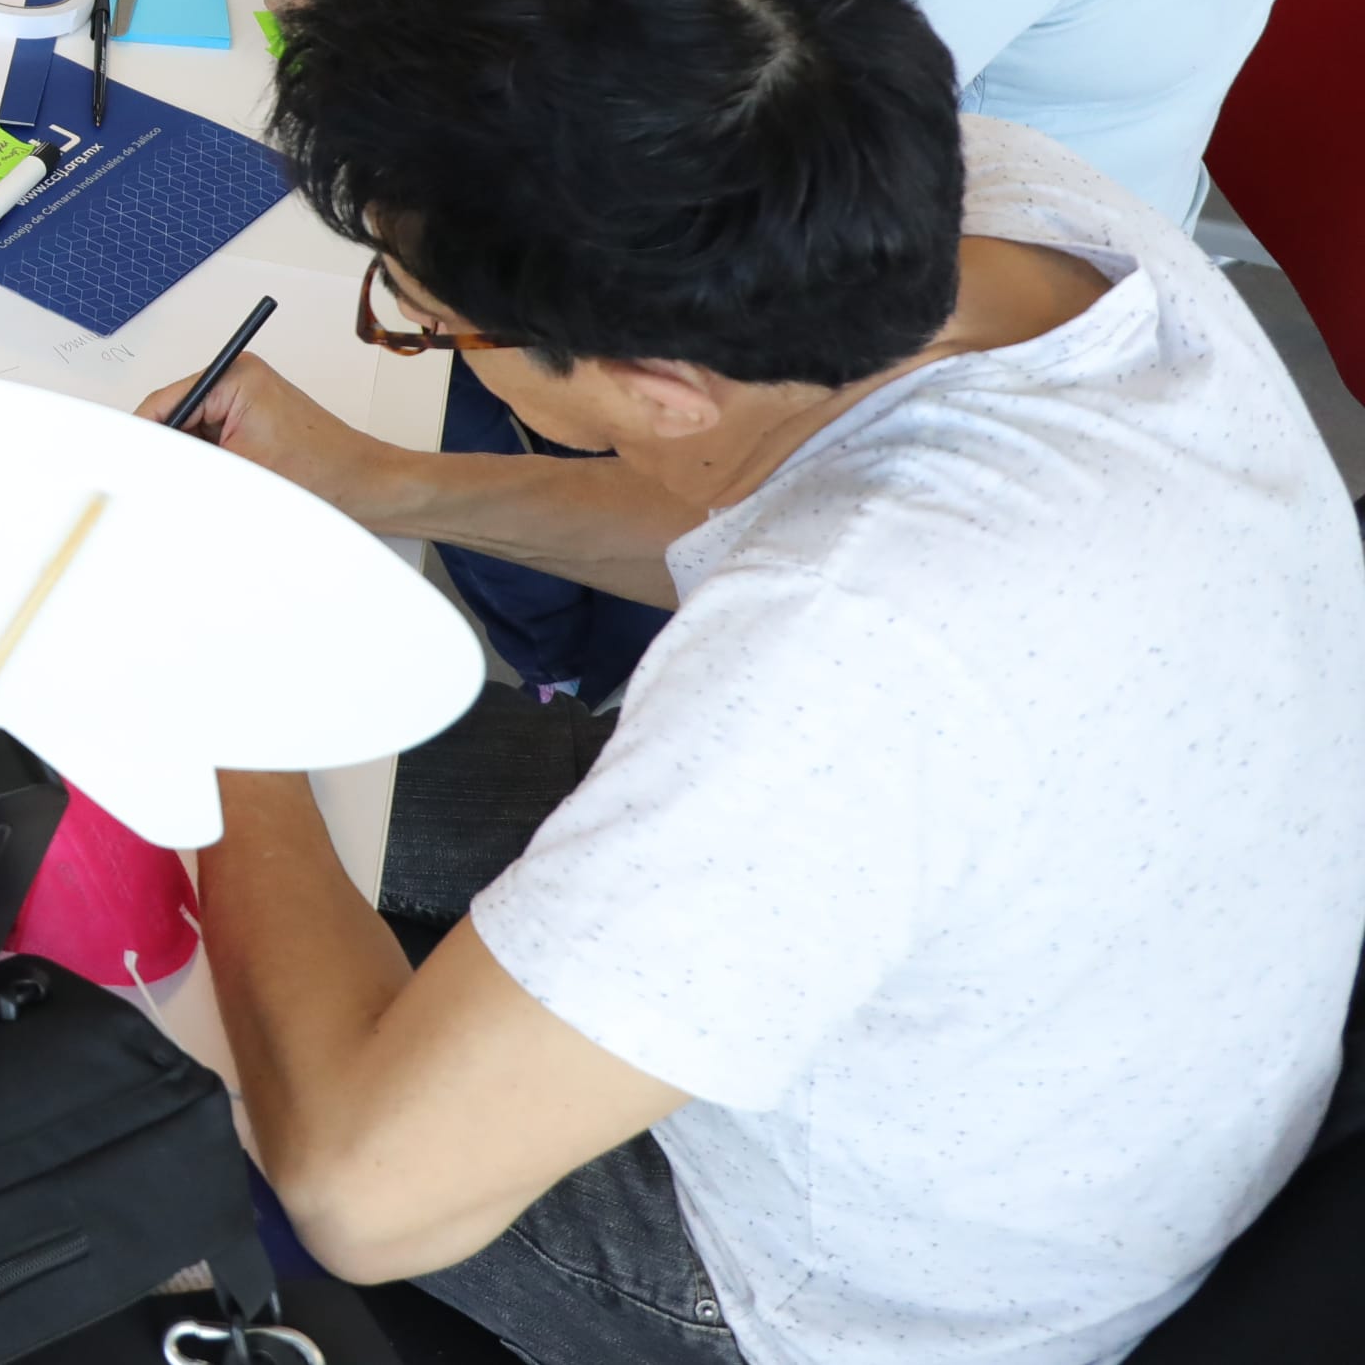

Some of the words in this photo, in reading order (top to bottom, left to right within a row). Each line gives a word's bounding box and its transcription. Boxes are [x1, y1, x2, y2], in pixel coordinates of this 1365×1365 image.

[21, 144, 103, 205] www.ccij.org.mx
[32, 213, 44, 224] de
[42, 189, 80, 214] Cámaras
[77, 156, 124, 189] Industriales
[123, 145, 135, 156] de
[133, 128, 161, 148] Jalisco
